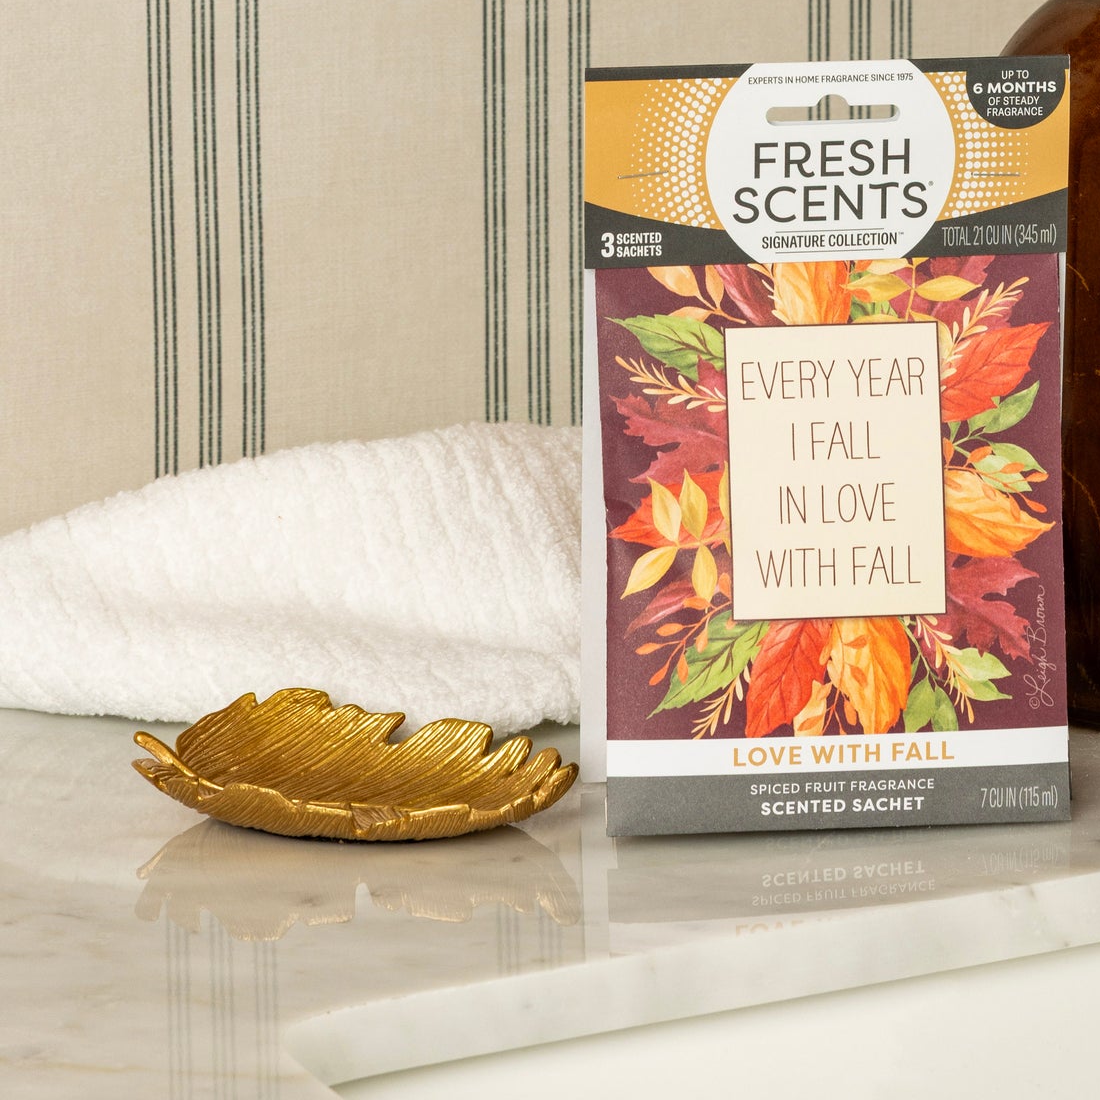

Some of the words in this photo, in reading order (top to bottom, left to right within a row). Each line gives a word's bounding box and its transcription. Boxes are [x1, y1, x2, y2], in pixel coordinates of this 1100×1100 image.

[748, 76, 783, 85] EXPERTS
[785, 76, 793, 84] IN
[795, 75, 819, 84] HOME
[821, 74, 868, 83] FRAGRANCE
[871, 73, 895, 82] SINCE
[897, 73, 913, 81] 1975
[1001, 70, 1014, 79] UP
[1016, 70, 1029, 79] TO
[973, 83, 983, 94] 6
[987, 81, 1057, 94] MONTHS
[986, 107, 1043, 117] FRAGRANCE
[988, 97, 1000, 105] OF
[1003, 96, 1040, 105] STEADY
[753, 137, 911, 180] FRESH
[601, 232, 615, 258] 3
[616, 232, 662, 245] SCENTED
[762, 234, 825, 249] SIGNATURE
[828, 232, 898, 247] COLLECTION
[942, 226, 971, 246] TOTAL
[973, 226, 984, 246] 21
[986, 225, 999, 245] CU
[1001, 225, 1012, 244] IN
[1014, 224, 1038, 247] (345
[616, 245, 662, 258] SACHETS
[741, 359, 836, 400] EVERY
[848, 357, 925, 397] YEAR
[791, 422, 796, 460] I
[810, 420, 881, 460] FALL
[779, 485, 807, 524] IN
[821, 482, 896, 523] LOVE
[756, 548, 837, 588] WITH
[852, 545, 921, 586] FALL
[1026, 584, 1047, 647] Brown
[733, 745, 803, 768] LOVE
[810, 742, 881, 765] WITH
[891, 740, 955, 763] FALL
[750, 783, 800, 795] SPICED
[805, 781, 846, 793] FRUIT
[850, 778, 935, 792] FRAGRANCE
[980, 788, 988, 808] 7
[989, 787, 1004, 808] CU
[1005, 786, 1017, 808] IN
[1018, 786, 1040, 810] (115
[761, 799, 846, 816] SCENTED
[852, 796, 925, 812] SACHET
